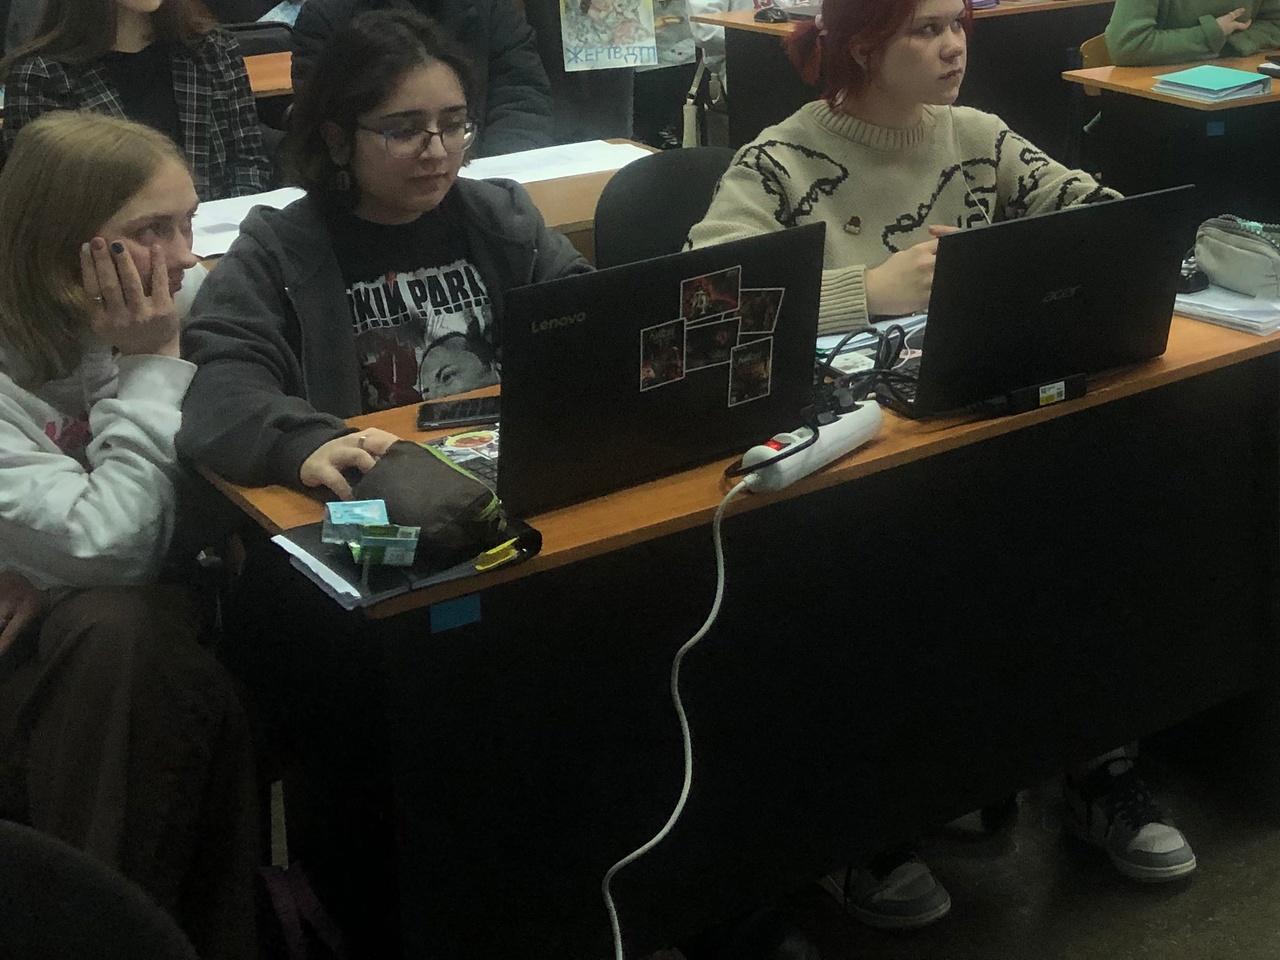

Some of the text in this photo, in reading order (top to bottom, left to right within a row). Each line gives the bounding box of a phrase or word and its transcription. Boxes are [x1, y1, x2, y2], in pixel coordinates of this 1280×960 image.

[565, 46, 623, 64] ЖЕРТВ
[1042, 284, 1081, 303] acer
[531, 311, 587, 333] Lenovo
